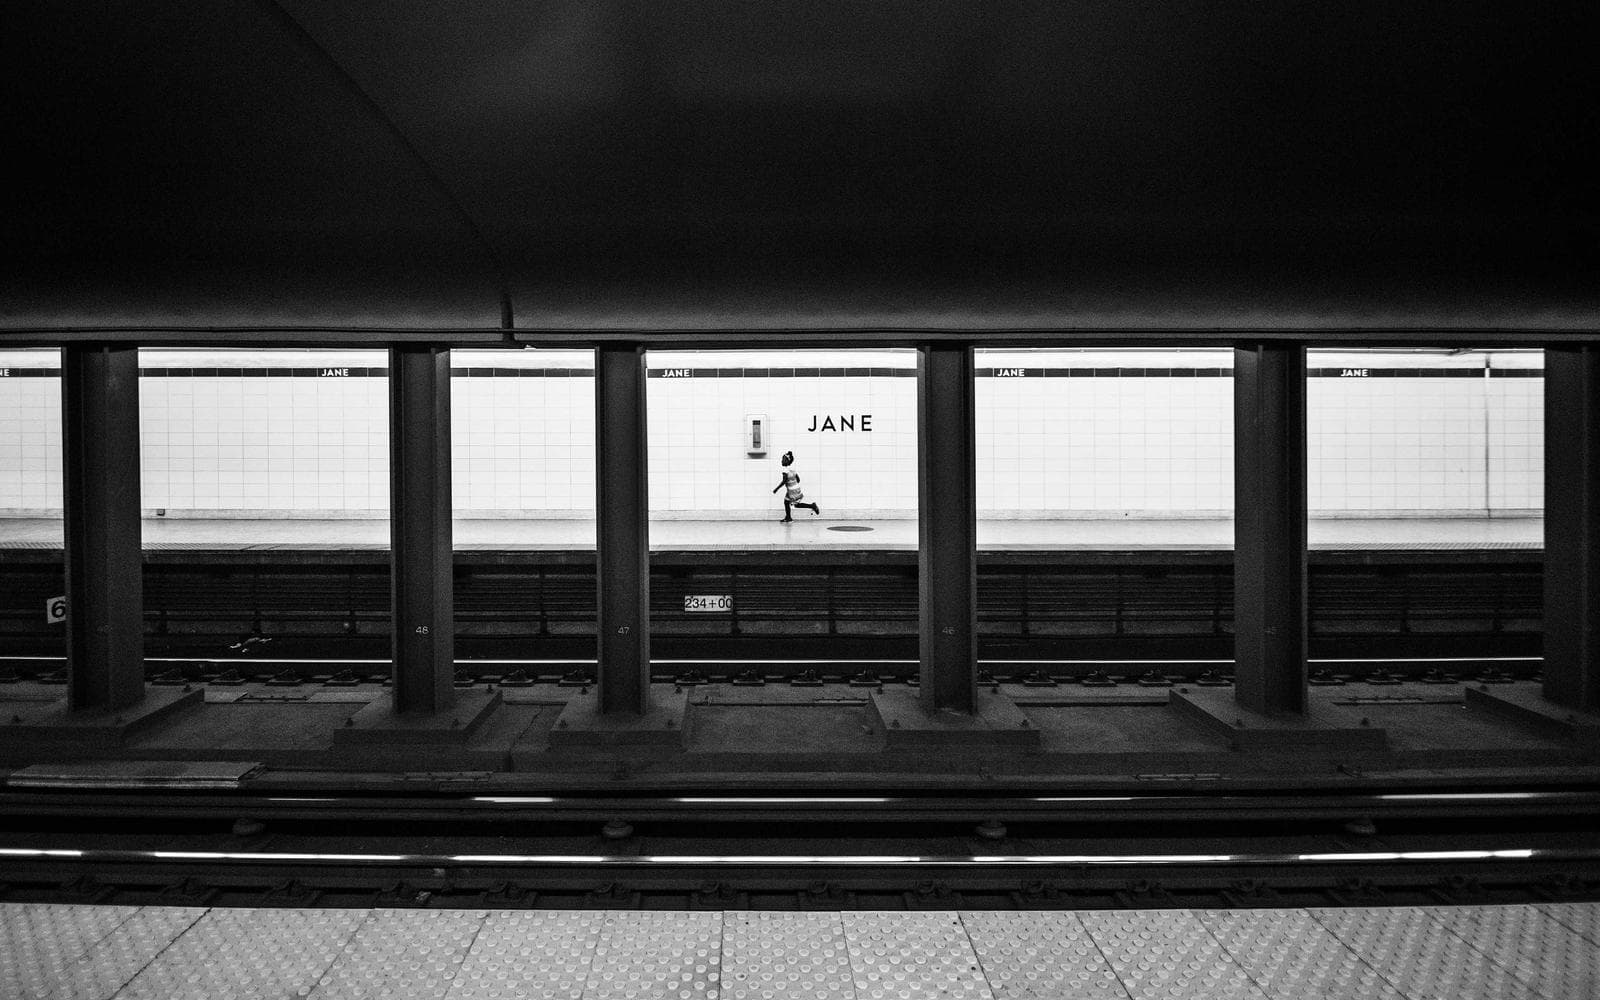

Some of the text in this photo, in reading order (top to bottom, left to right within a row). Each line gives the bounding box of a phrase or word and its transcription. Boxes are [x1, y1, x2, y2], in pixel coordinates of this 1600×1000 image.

[321, 368, 349, 377] JANE
[662, 369, 690, 378] JANE
[997, 368, 1025, 377] JANE
[1340, 369, 1368, 377] JANE
[807, 414, 873, 432] JANE
[685, 597, 733, 609] 234+00
[51, 600, 66, 618] 6
[415, 625, 429, 635] 48
[617, 626, 630, 635] 47
